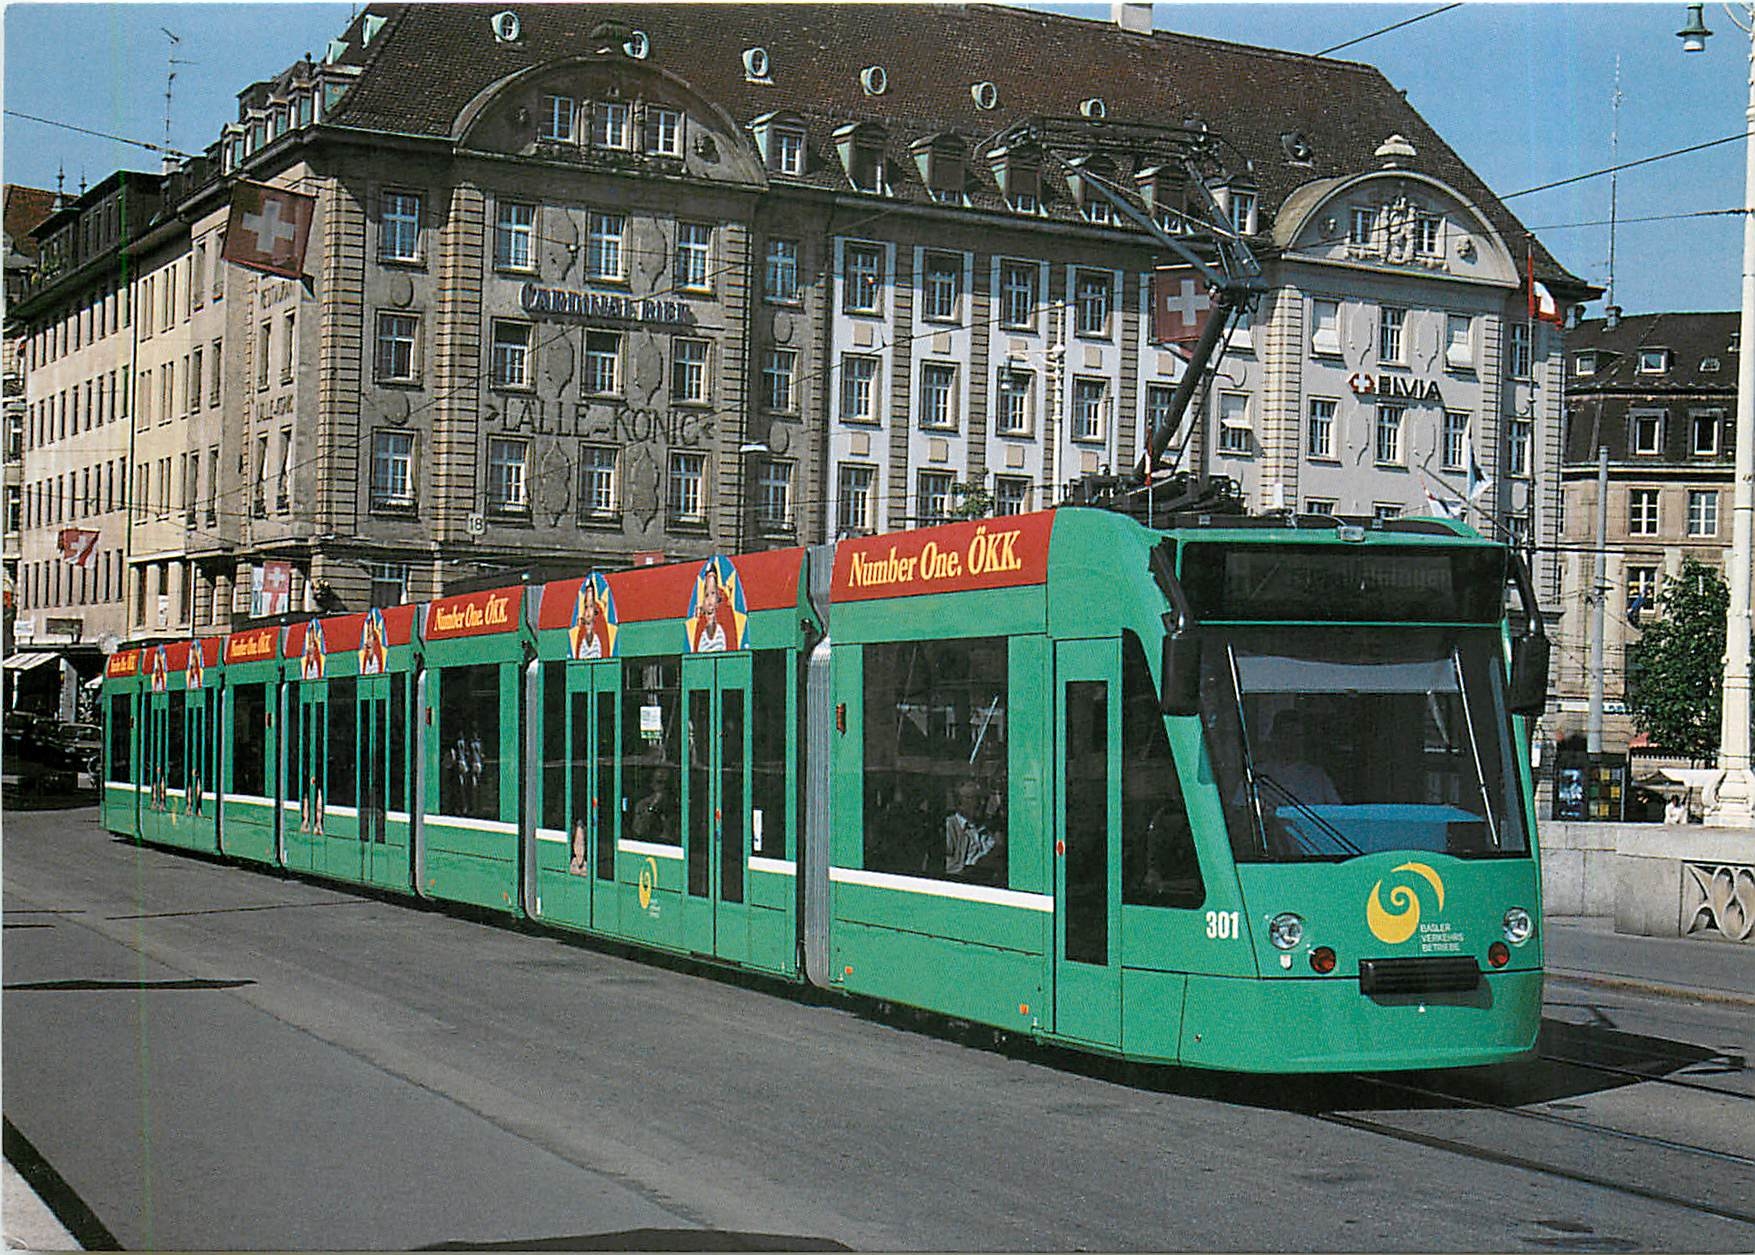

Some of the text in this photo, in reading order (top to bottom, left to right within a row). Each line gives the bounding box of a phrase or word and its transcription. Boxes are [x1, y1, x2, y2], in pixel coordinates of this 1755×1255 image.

[470, 517, 482, 531] 18
[848, 525, 1022, 587] Number One. ÖKK.
[1206, 911, 1239, 939] 301
